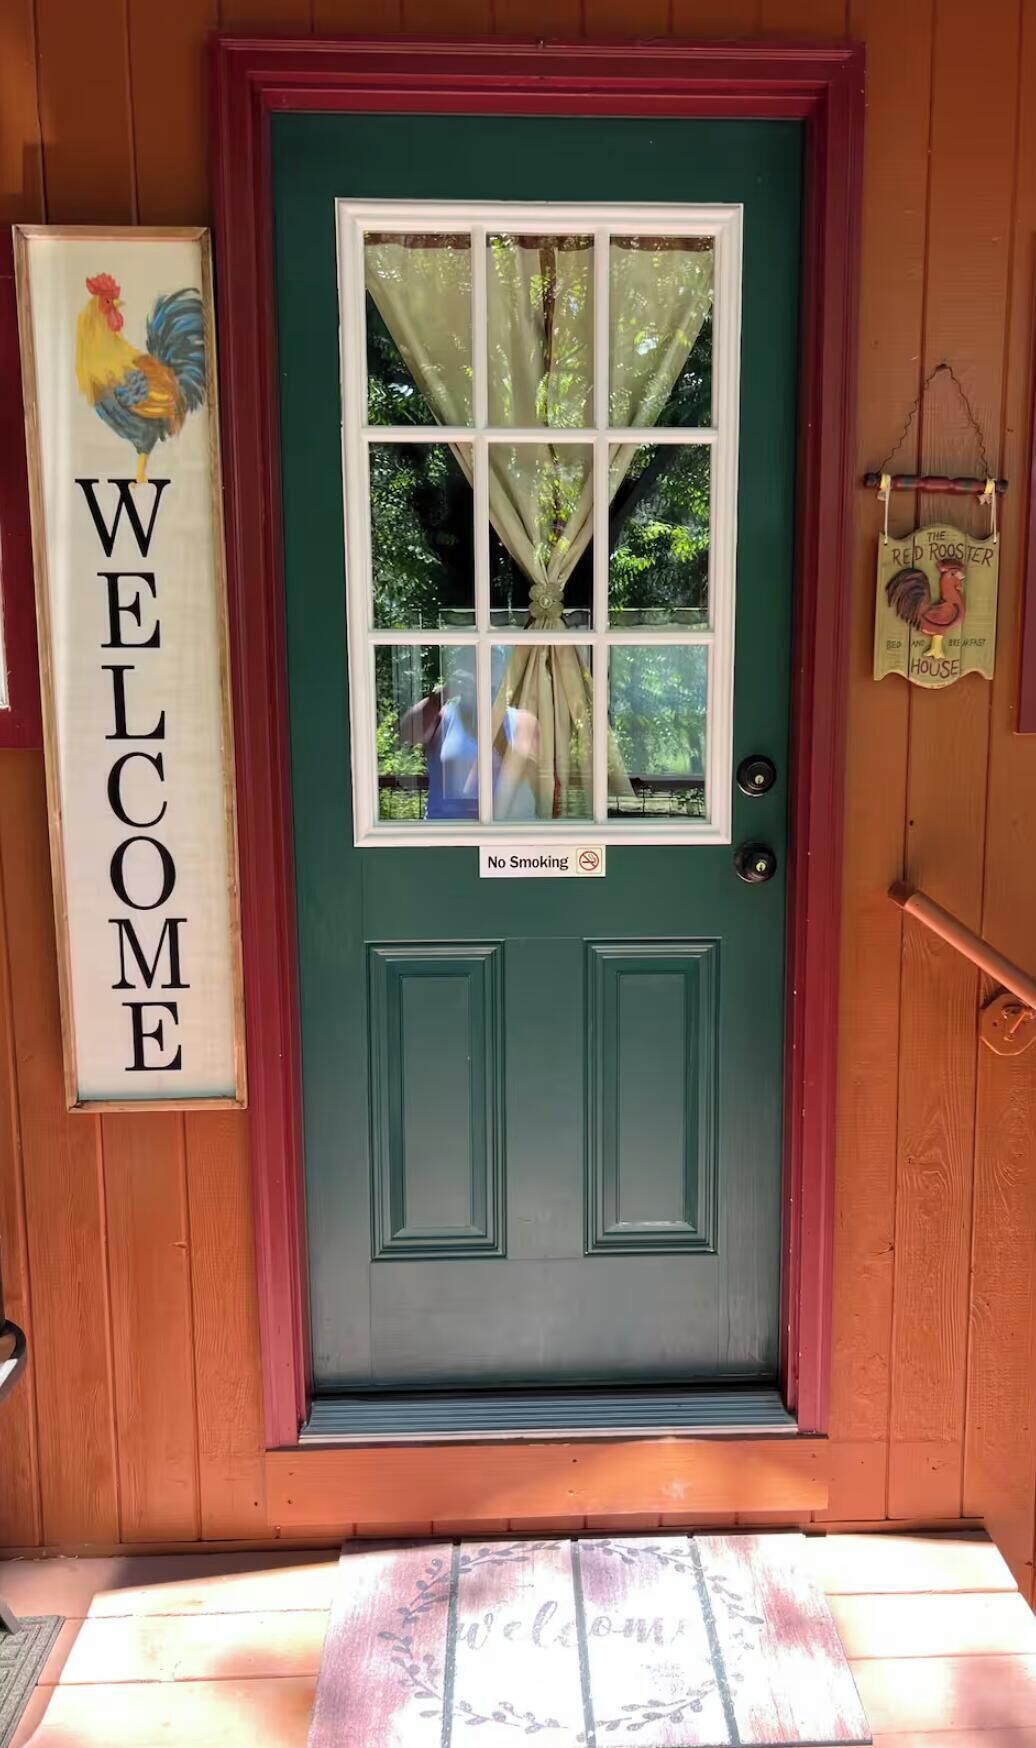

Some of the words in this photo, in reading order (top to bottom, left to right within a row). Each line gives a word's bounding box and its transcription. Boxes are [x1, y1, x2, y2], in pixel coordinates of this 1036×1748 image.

[926, 531, 947, 543] THE
[892, 545, 924, 567] RED
[929, 542, 994, 568] ROOSTER
[886, 639, 902, 650] BED
[911, 658, 961, 679] HOUSE
[74, 478, 191, 1073] WELCOME
[487, 855, 506, 869] No
[509, 855, 569, 871] Smoking
